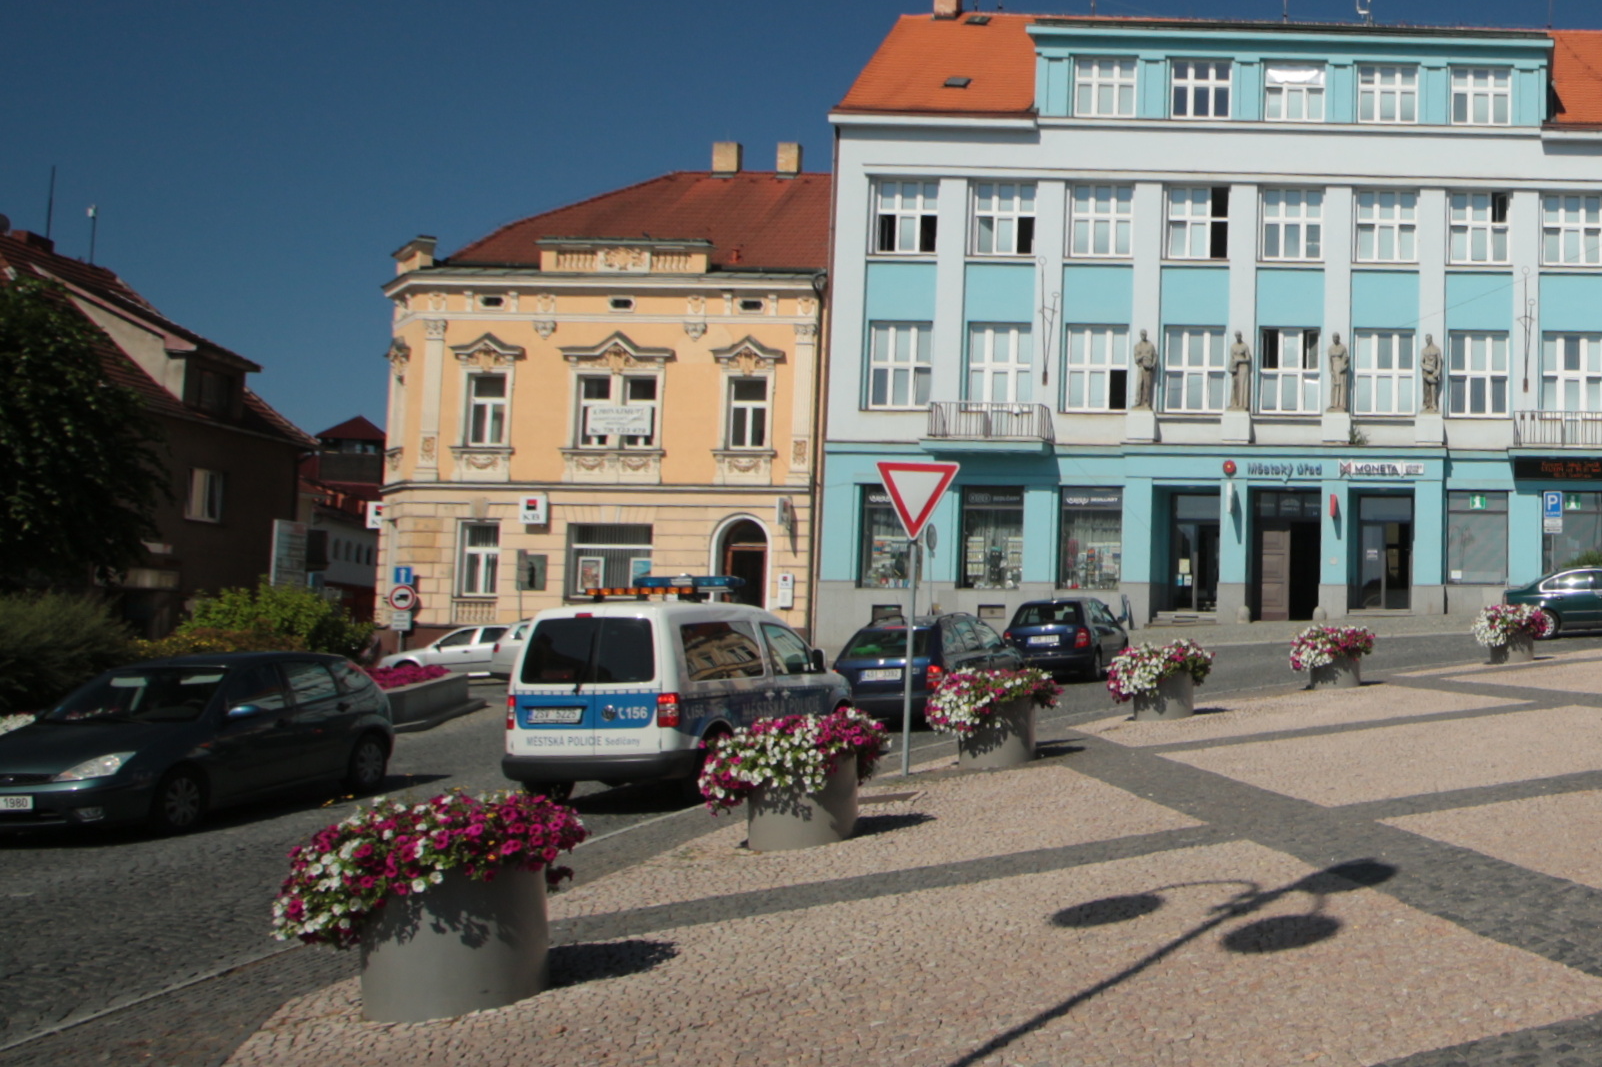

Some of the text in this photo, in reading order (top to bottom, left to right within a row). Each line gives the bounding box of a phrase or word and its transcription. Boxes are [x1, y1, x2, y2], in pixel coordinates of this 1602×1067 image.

[1355, 464, 1399, 475] MONETA
[1547, 494, 1559, 511] P
[522, 513, 540, 521] KB
[626, 706, 648, 719] 156
[526, 734, 641, 747] MĚSTSKÁ POLICIE Sedlčany
[3, 797, 28, 808] 1980
